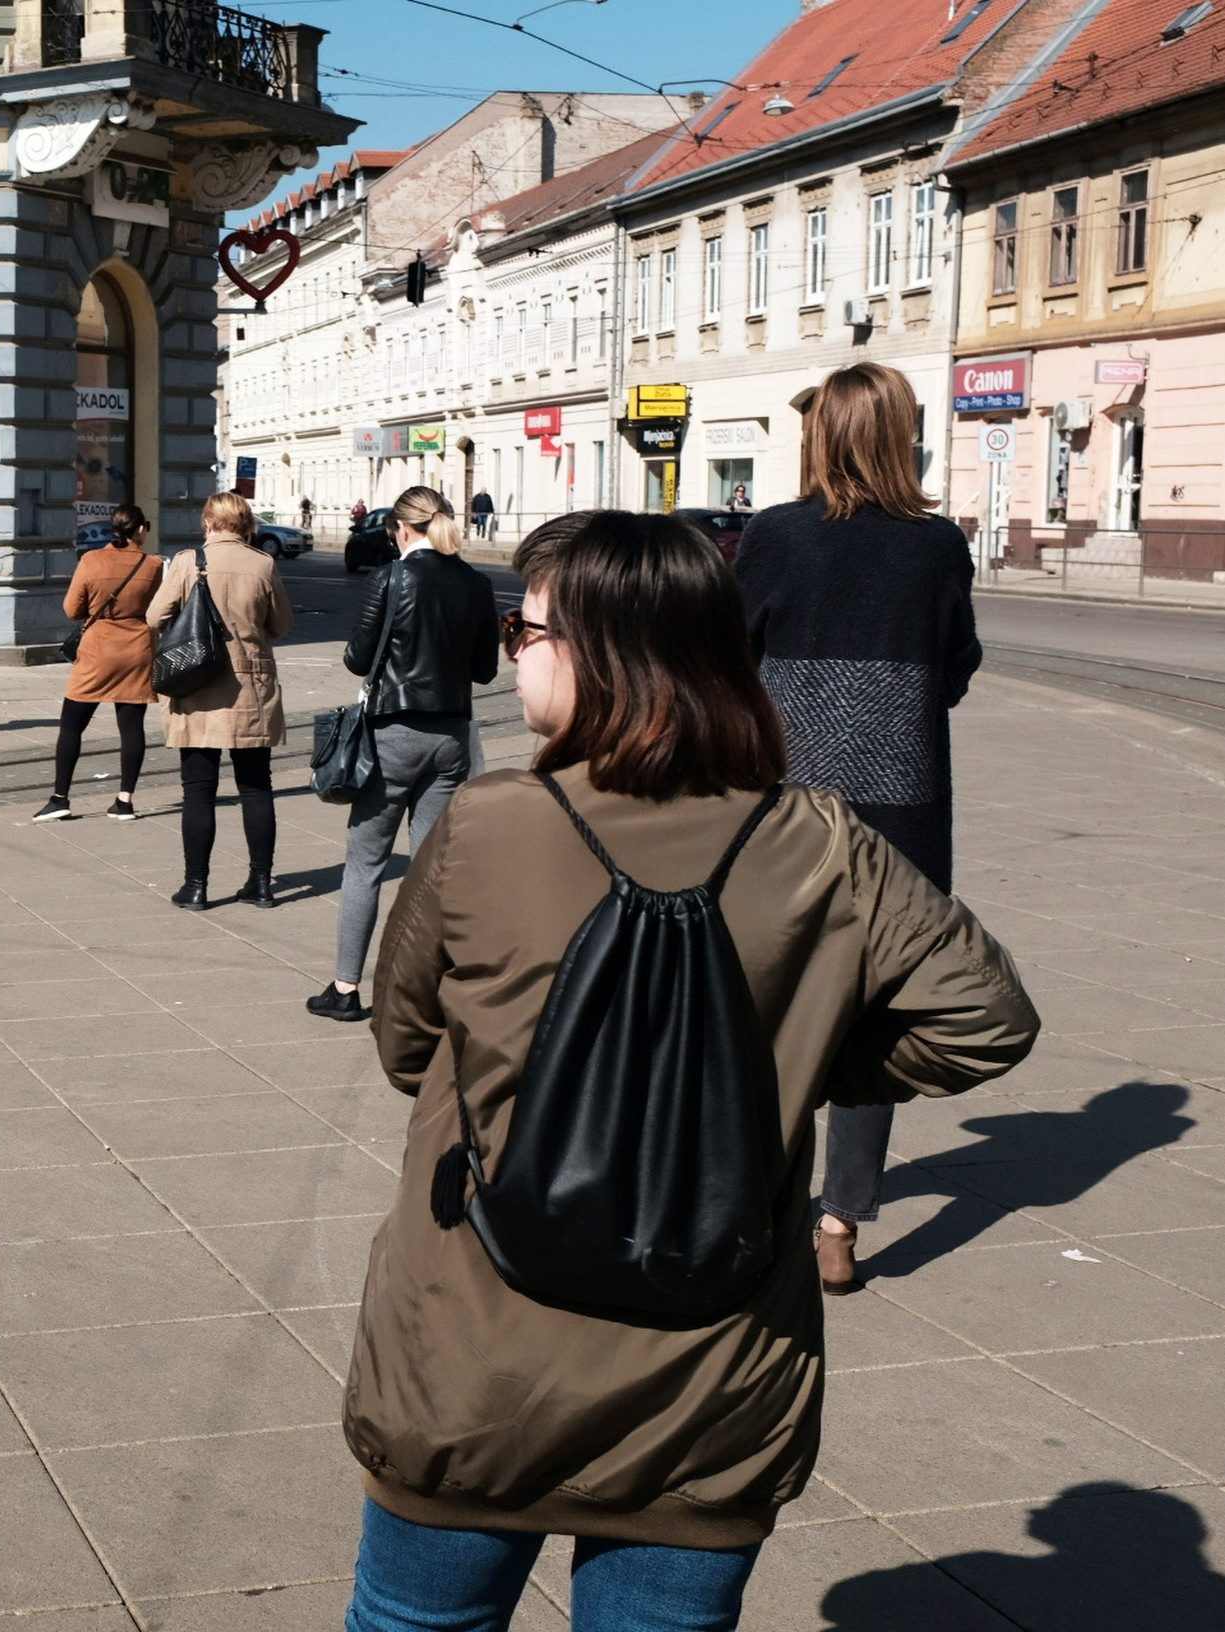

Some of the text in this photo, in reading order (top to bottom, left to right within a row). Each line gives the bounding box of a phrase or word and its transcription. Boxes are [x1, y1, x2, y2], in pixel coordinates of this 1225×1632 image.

[963, 368, 1014, 394] Canon
[77, 393, 125, 410] KADOL
[991, 434, 1005, 445] 30
